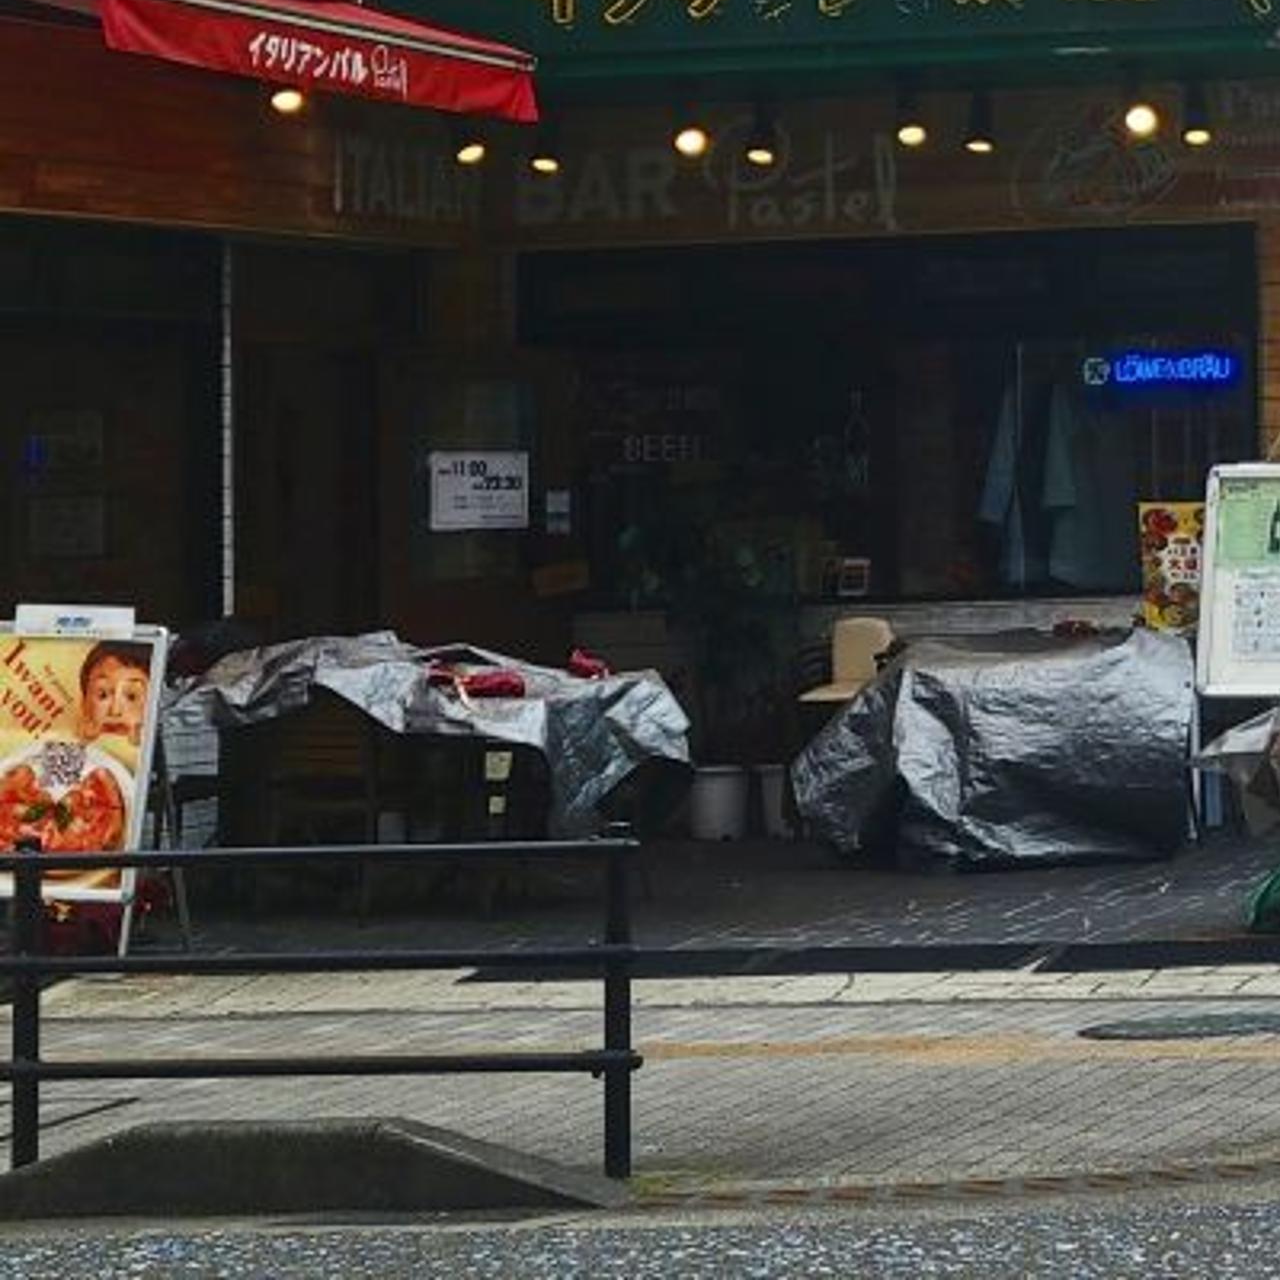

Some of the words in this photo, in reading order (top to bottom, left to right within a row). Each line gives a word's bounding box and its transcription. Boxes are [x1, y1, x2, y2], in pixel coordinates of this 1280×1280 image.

[248, 30, 367, 85] イタリアンバル
[0, 688, 52, 740] you!
[14, 660, 65, 719] want
